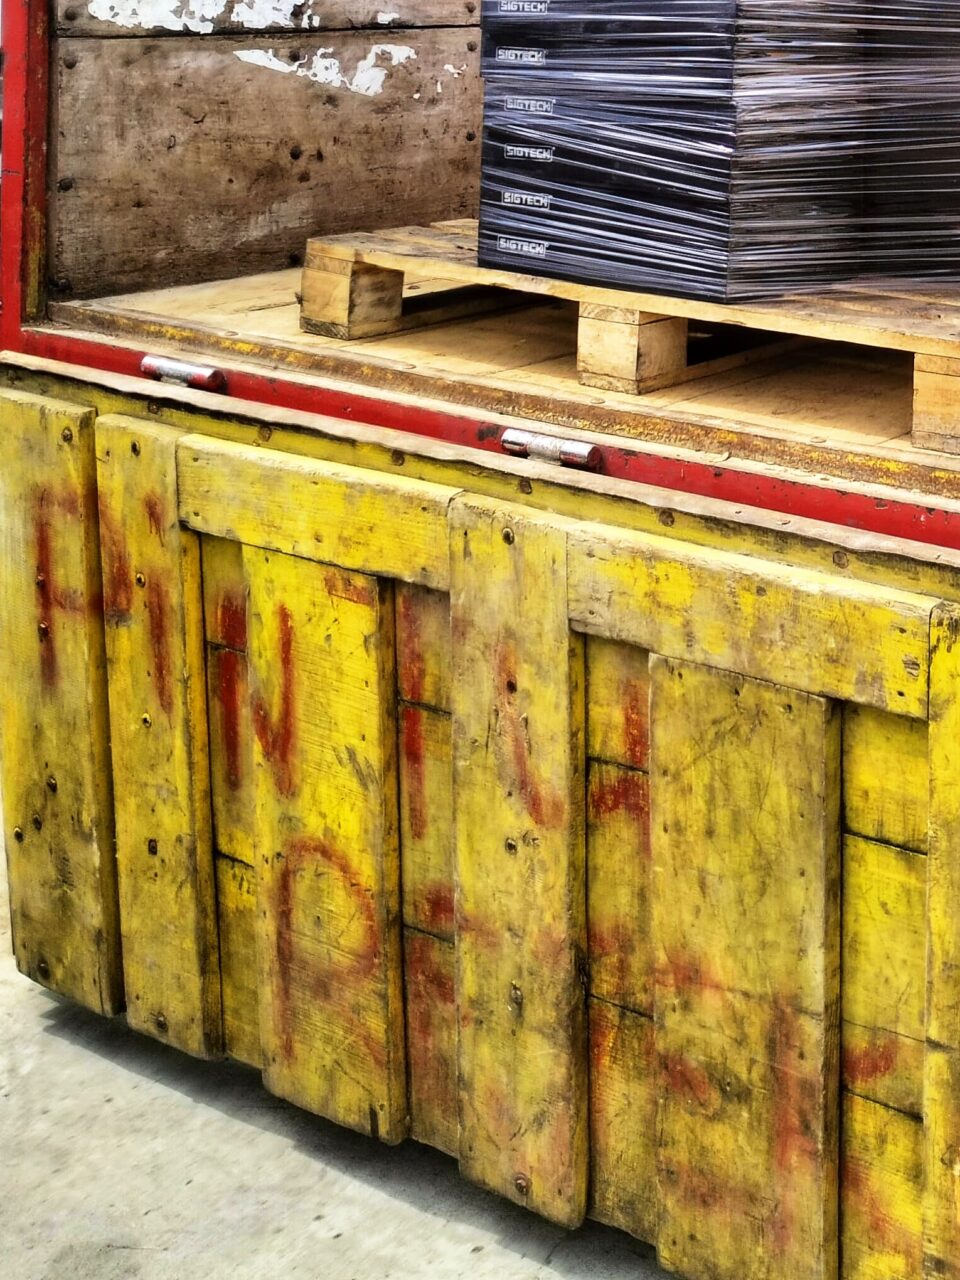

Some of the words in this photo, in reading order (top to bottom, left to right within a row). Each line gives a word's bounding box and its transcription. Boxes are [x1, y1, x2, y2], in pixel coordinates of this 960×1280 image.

[499, 0, 546, 13] SIGTECH
[497, 48, 545, 63] SIGTECH
[506, 97, 552, 113] SIGTECH
[506, 146, 551, 160] SIGTECH
[503, 192, 549, 207] SIGTECH
[498, 238, 545, 254] SIGTECH
